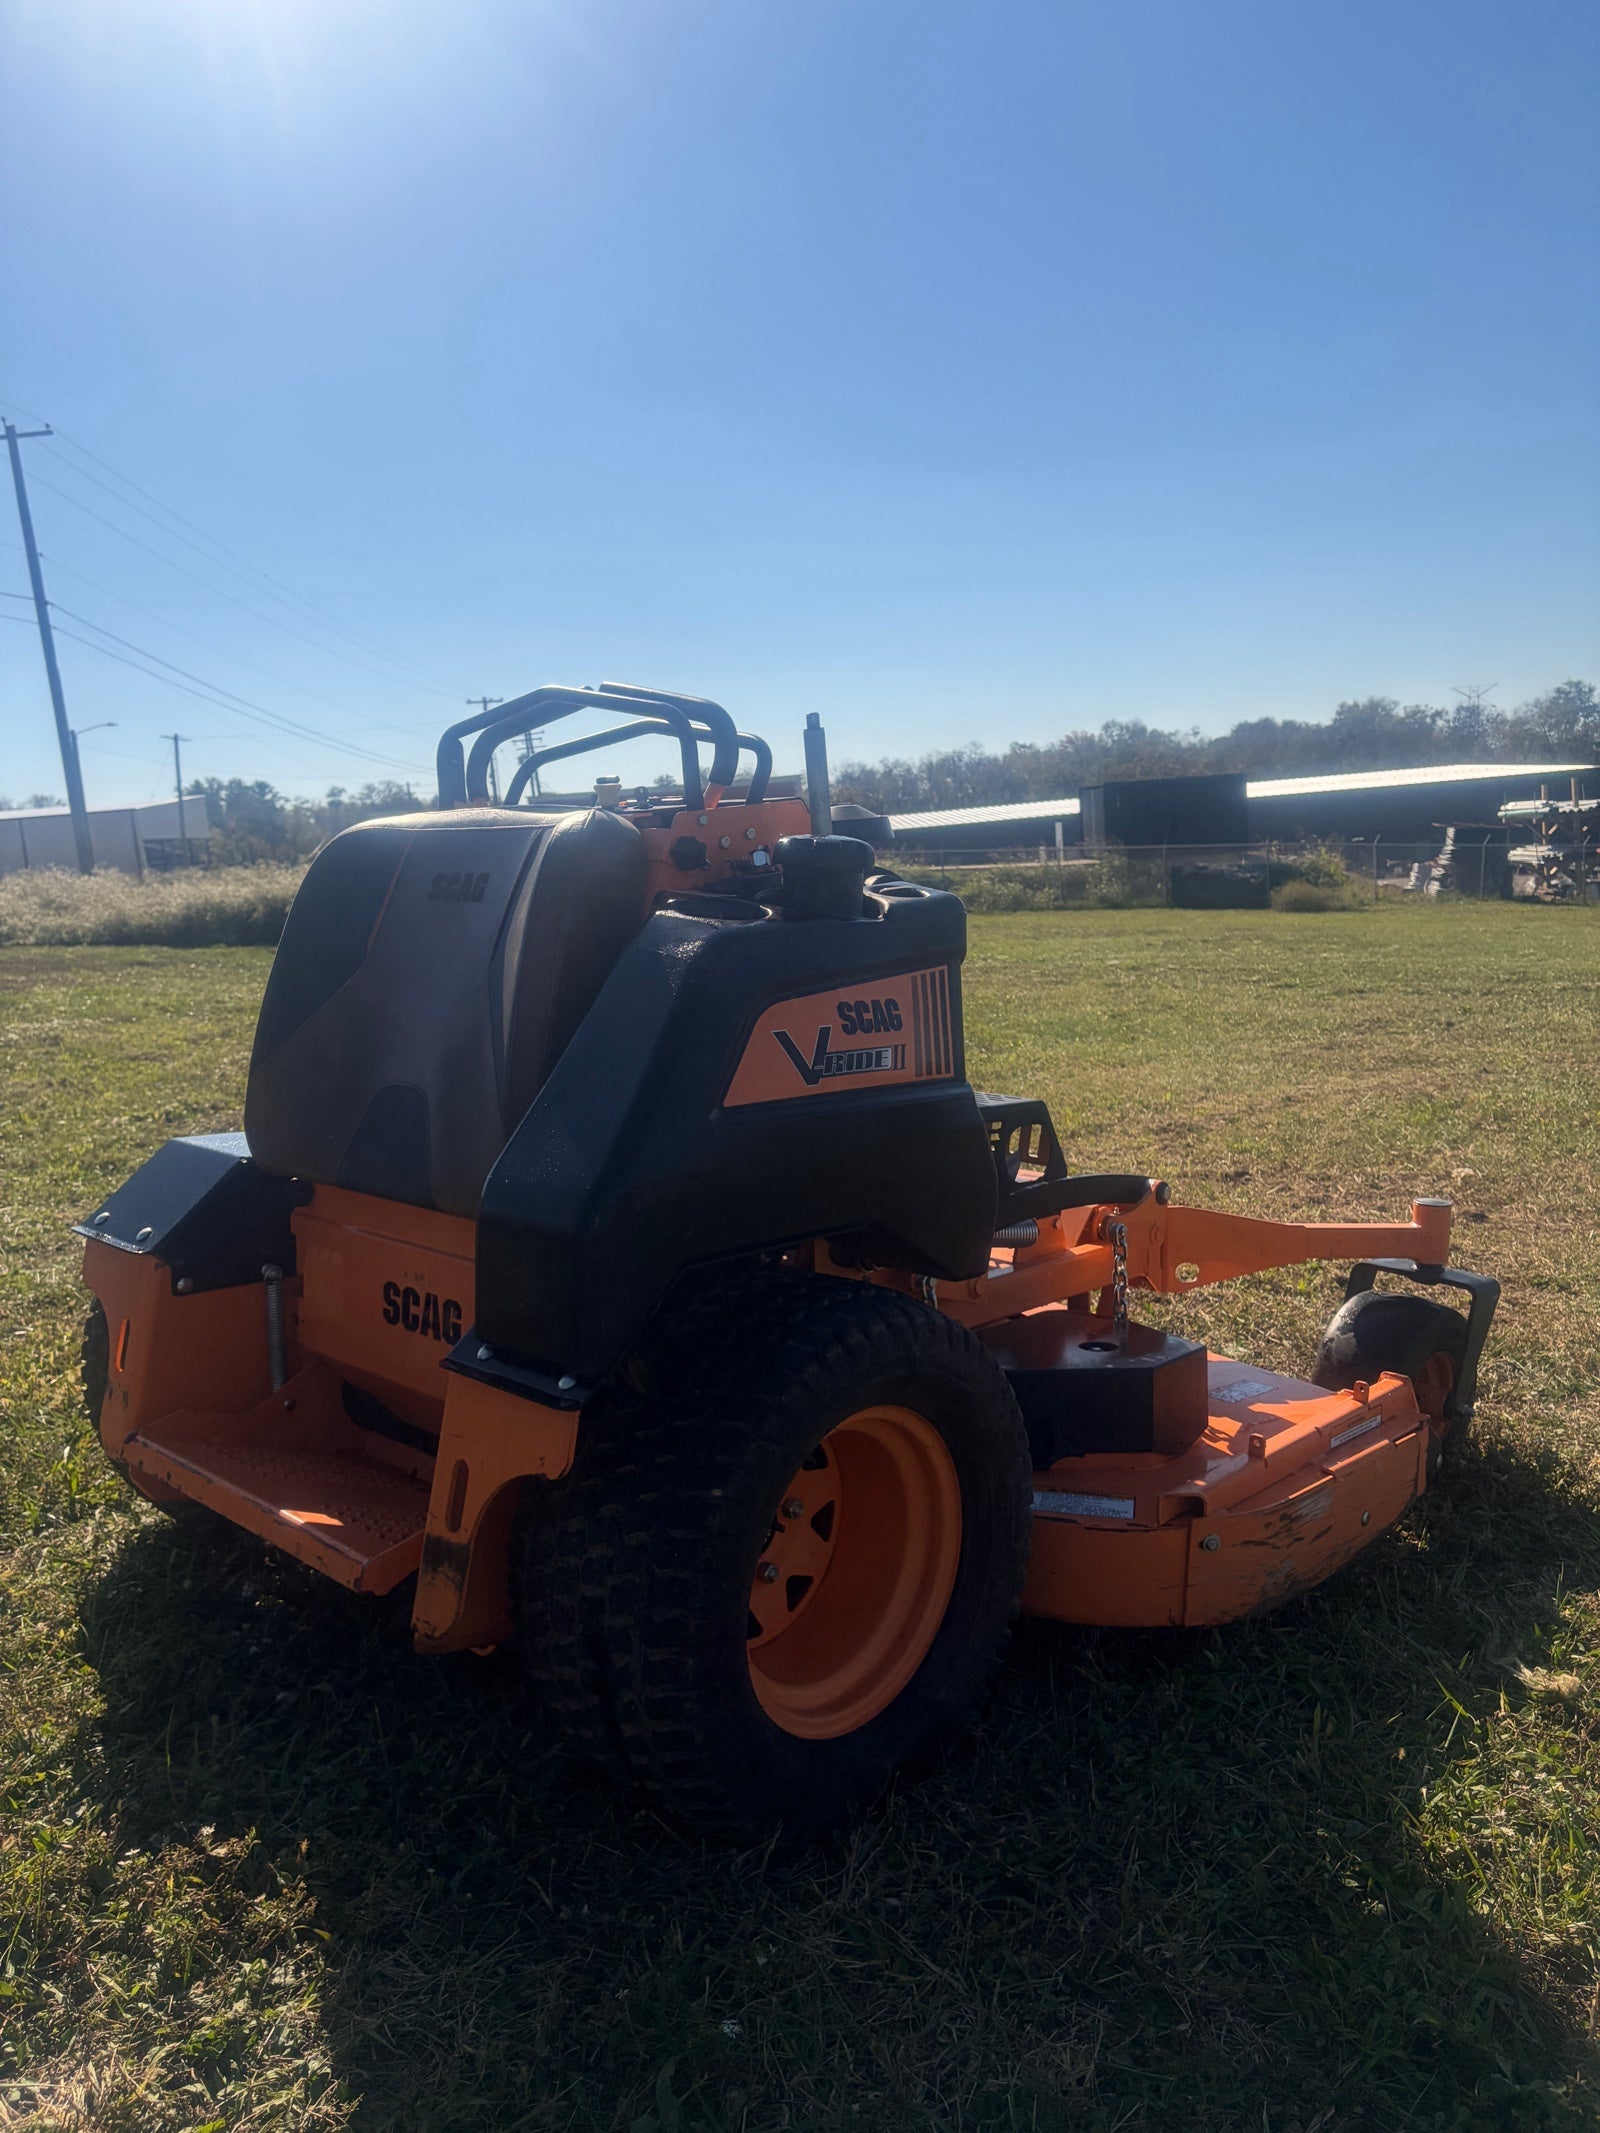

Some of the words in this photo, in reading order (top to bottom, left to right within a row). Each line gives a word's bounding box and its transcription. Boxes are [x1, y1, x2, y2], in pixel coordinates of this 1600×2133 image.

[428, 872, 490, 903] SCAG
[836, 998, 903, 1035] SCAG
[382, 1280, 462, 1346] SCAG
